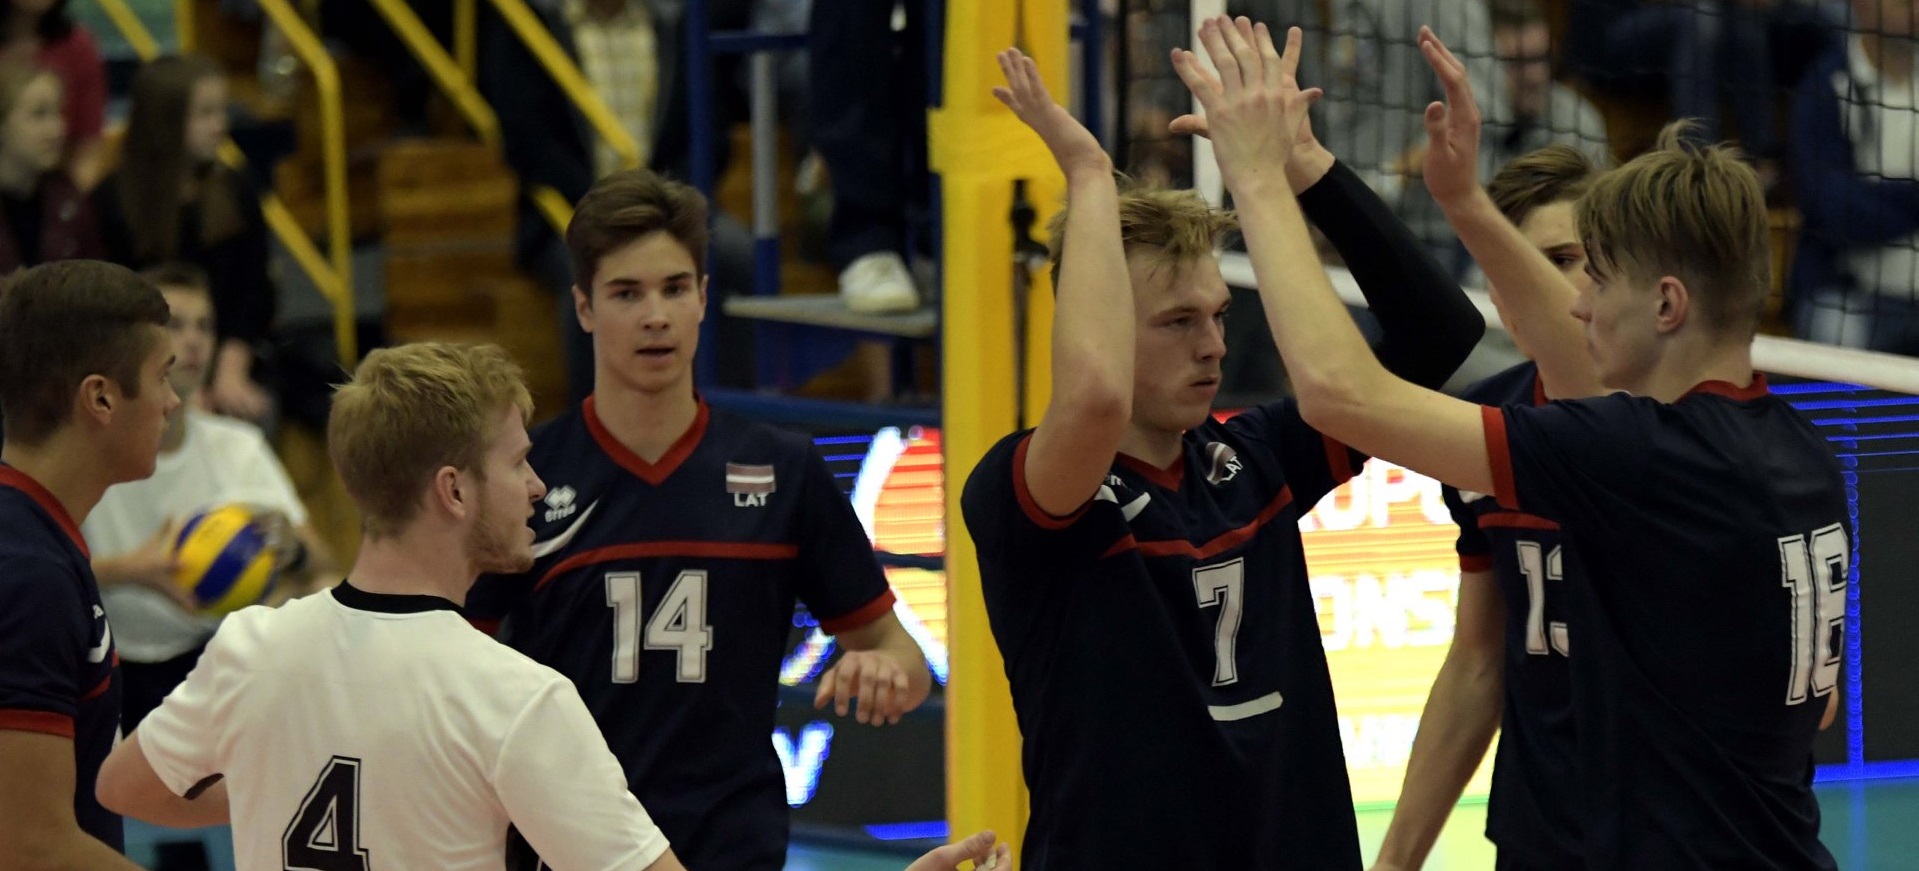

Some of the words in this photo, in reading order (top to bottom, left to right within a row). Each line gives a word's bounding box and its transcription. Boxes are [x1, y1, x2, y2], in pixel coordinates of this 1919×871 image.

[734, 492, 769, 507] LAT
[1220, 456, 1243, 481] LAT
[605, 570, 713, 683] 14
[1192, 557, 1244, 687] 7
[282, 755, 371, 871] 4
